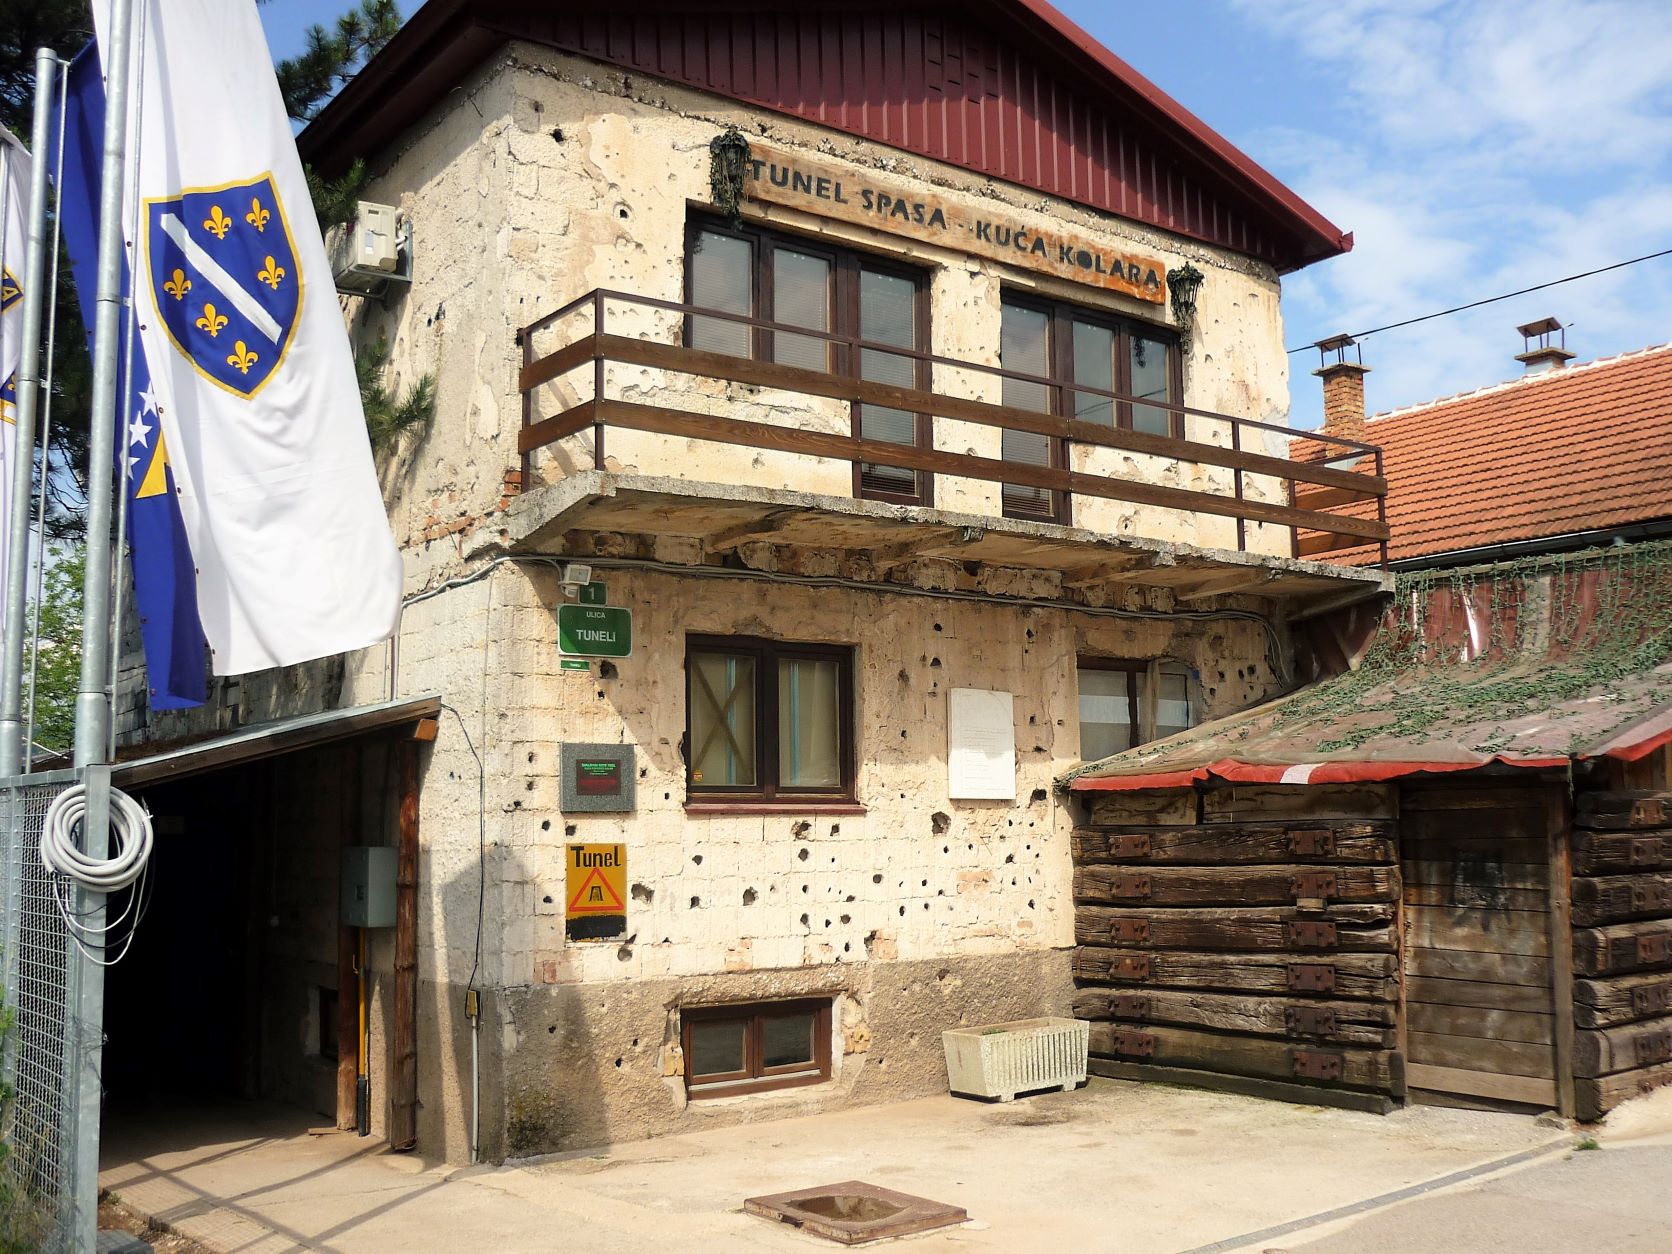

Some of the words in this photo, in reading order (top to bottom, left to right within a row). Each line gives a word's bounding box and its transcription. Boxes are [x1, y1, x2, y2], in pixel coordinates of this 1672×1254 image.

[750, 159, 849, 205] TUNEL
[861, 189, 947, 231] SPASA
[975, 220, 1048, 259] KUĆA
[1059, 243, 1161, 290] KOLARA
[588, 587, 595, 600] 1
[586, 611, 606, 619] ULICA
[576, 629, 616, 642] TUNELI
[570, 846, 622, 868] Tunel
